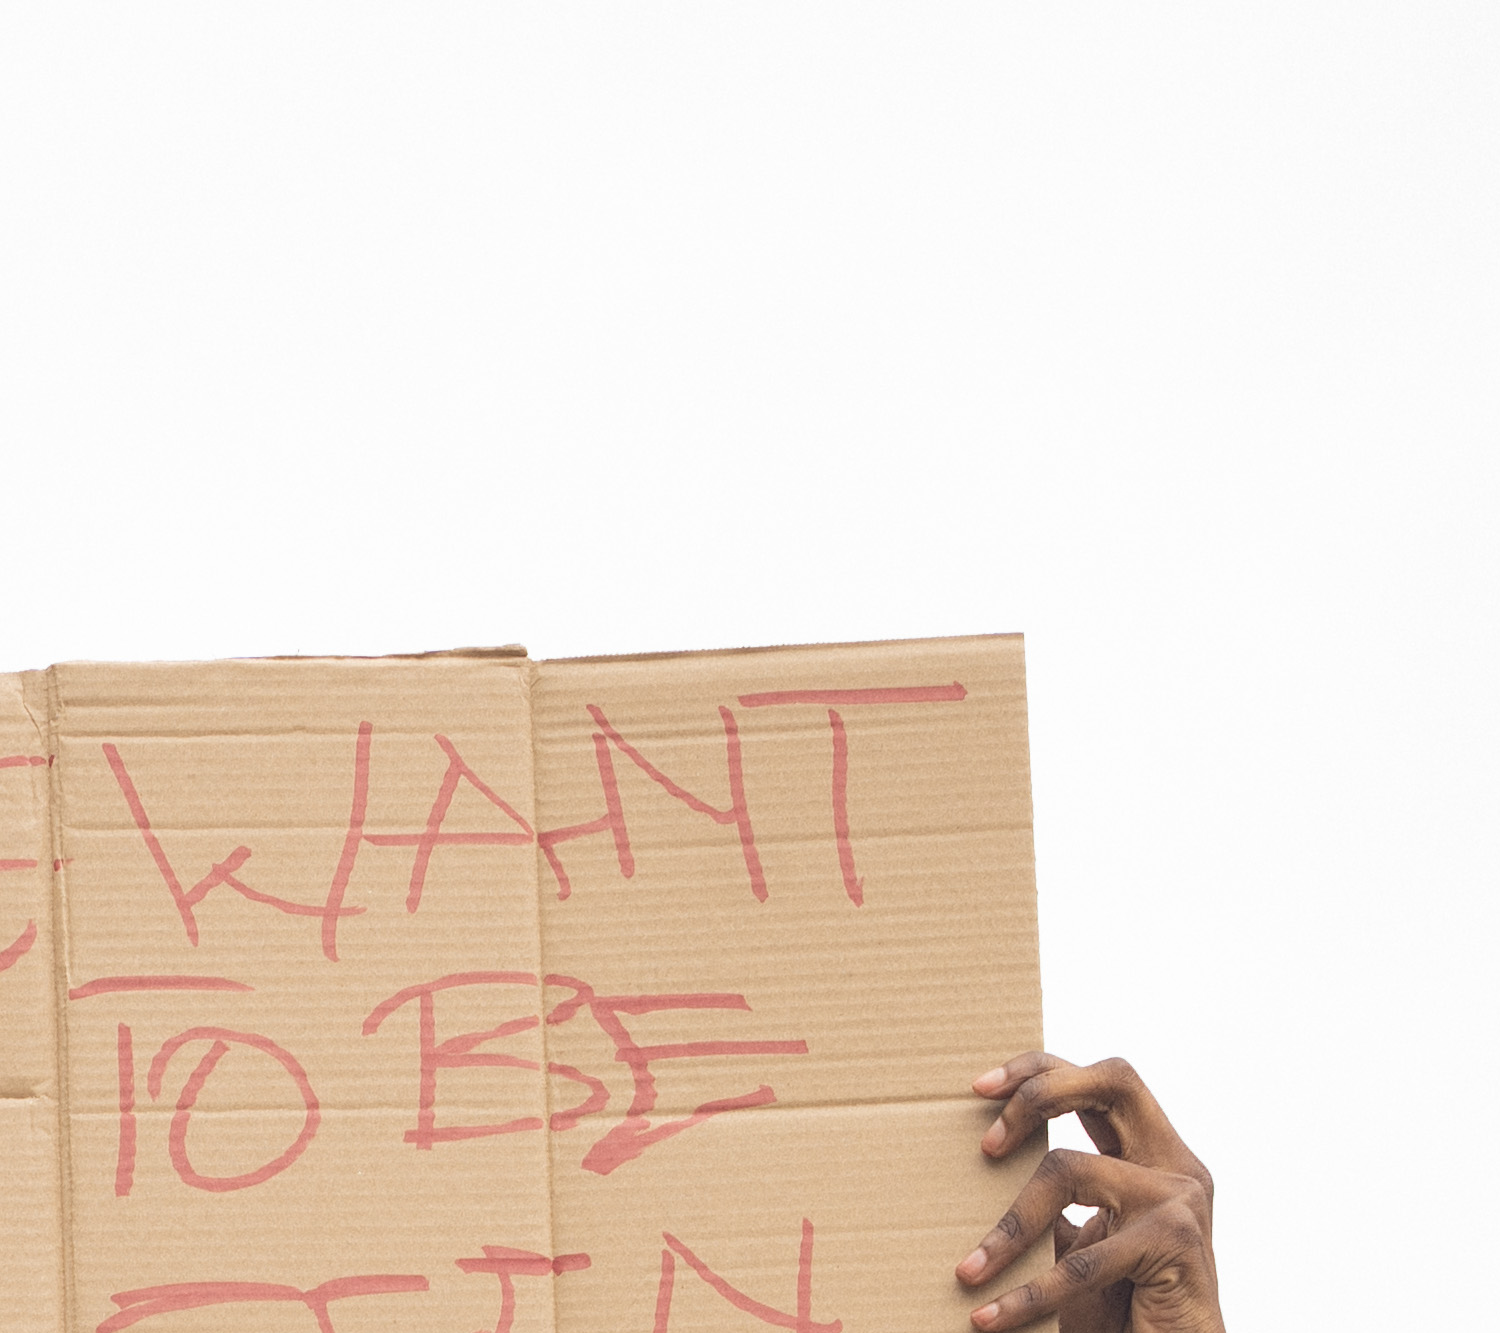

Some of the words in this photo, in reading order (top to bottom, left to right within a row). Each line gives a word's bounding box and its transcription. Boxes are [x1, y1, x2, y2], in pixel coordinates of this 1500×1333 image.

[102, 680, 967, 961] WANT
[69, 974, 320, 1198] TO
[361, 971, 809, 1178] BE
